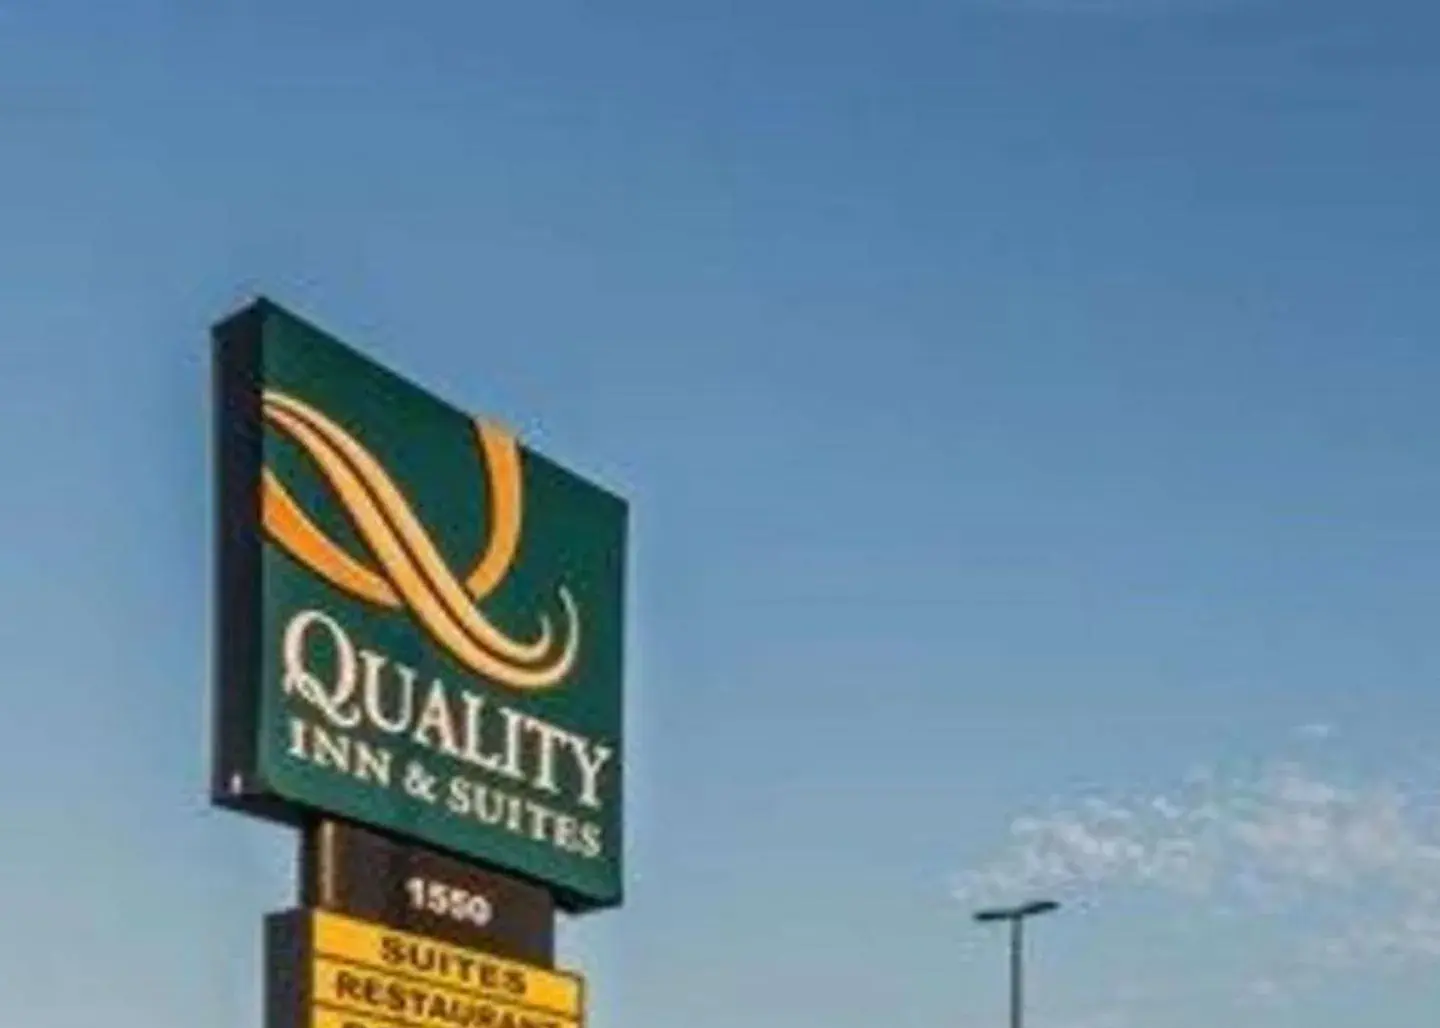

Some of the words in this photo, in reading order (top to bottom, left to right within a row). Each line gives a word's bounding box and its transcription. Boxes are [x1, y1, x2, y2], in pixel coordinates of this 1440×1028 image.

[282, 609, 612, 807] QUALITY
[286, 716, 393, 786] INN
[404, 760, 436, 802] &
[448, 774, 602, 858] SUITES
[405, 876, 492, 925] 1550
[380, 935, 528, 995] SUITES
